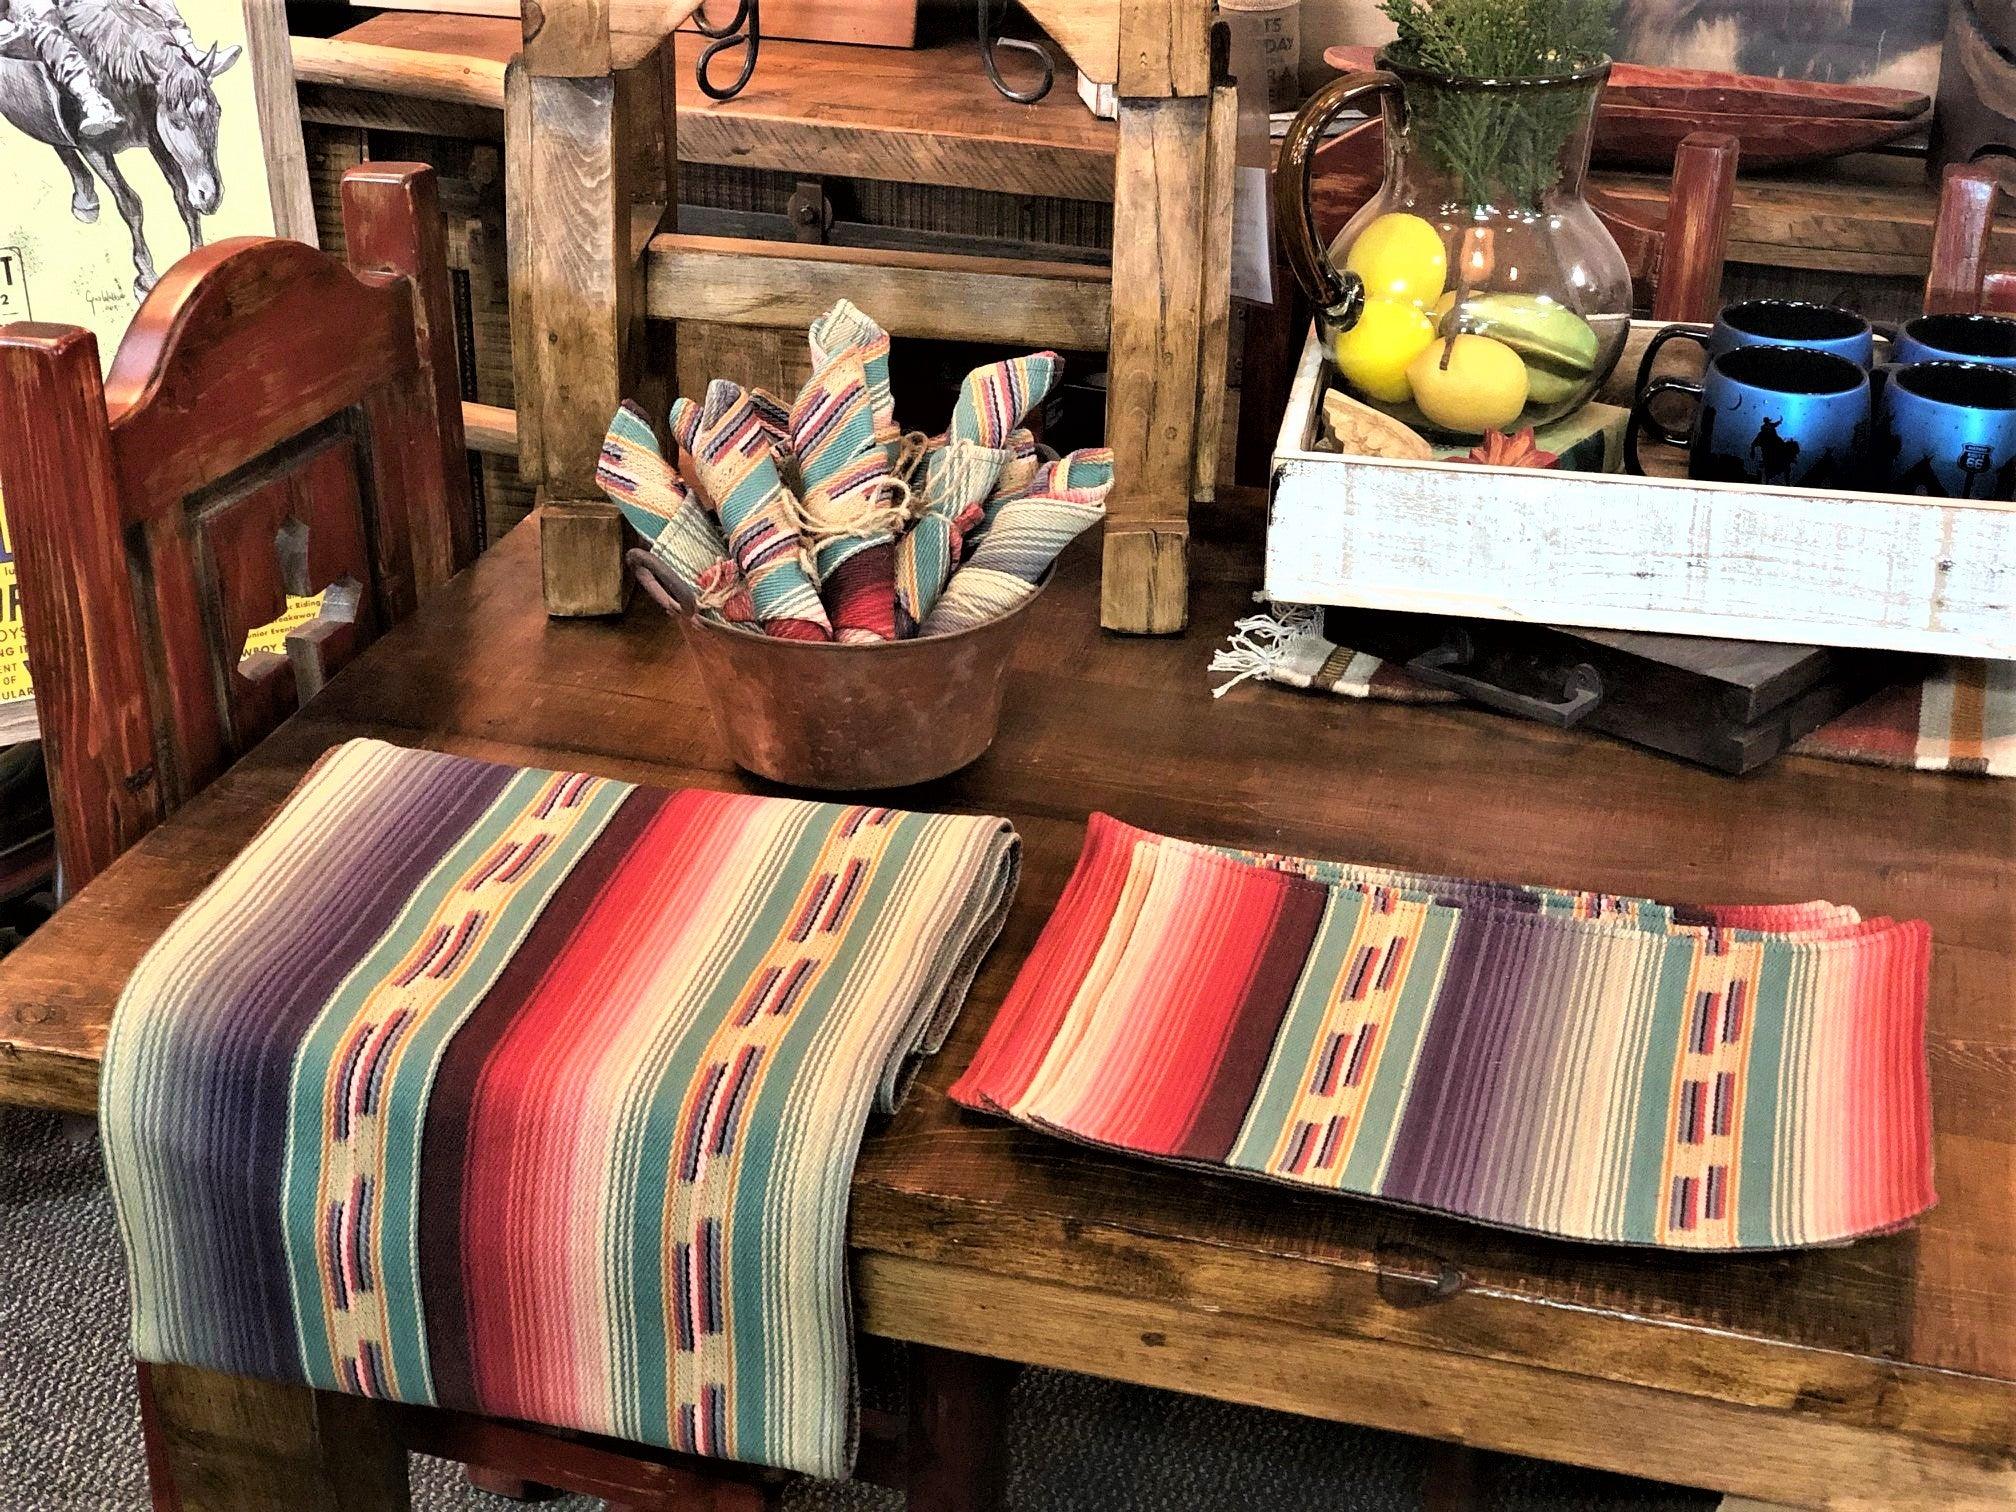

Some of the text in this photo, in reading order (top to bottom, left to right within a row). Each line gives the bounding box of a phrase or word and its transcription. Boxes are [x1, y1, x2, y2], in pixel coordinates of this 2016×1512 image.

[1966, 457, 1985, 469] 66
[295, 600, 321, 609] Riding
[3, 675, 17, 685] OF
